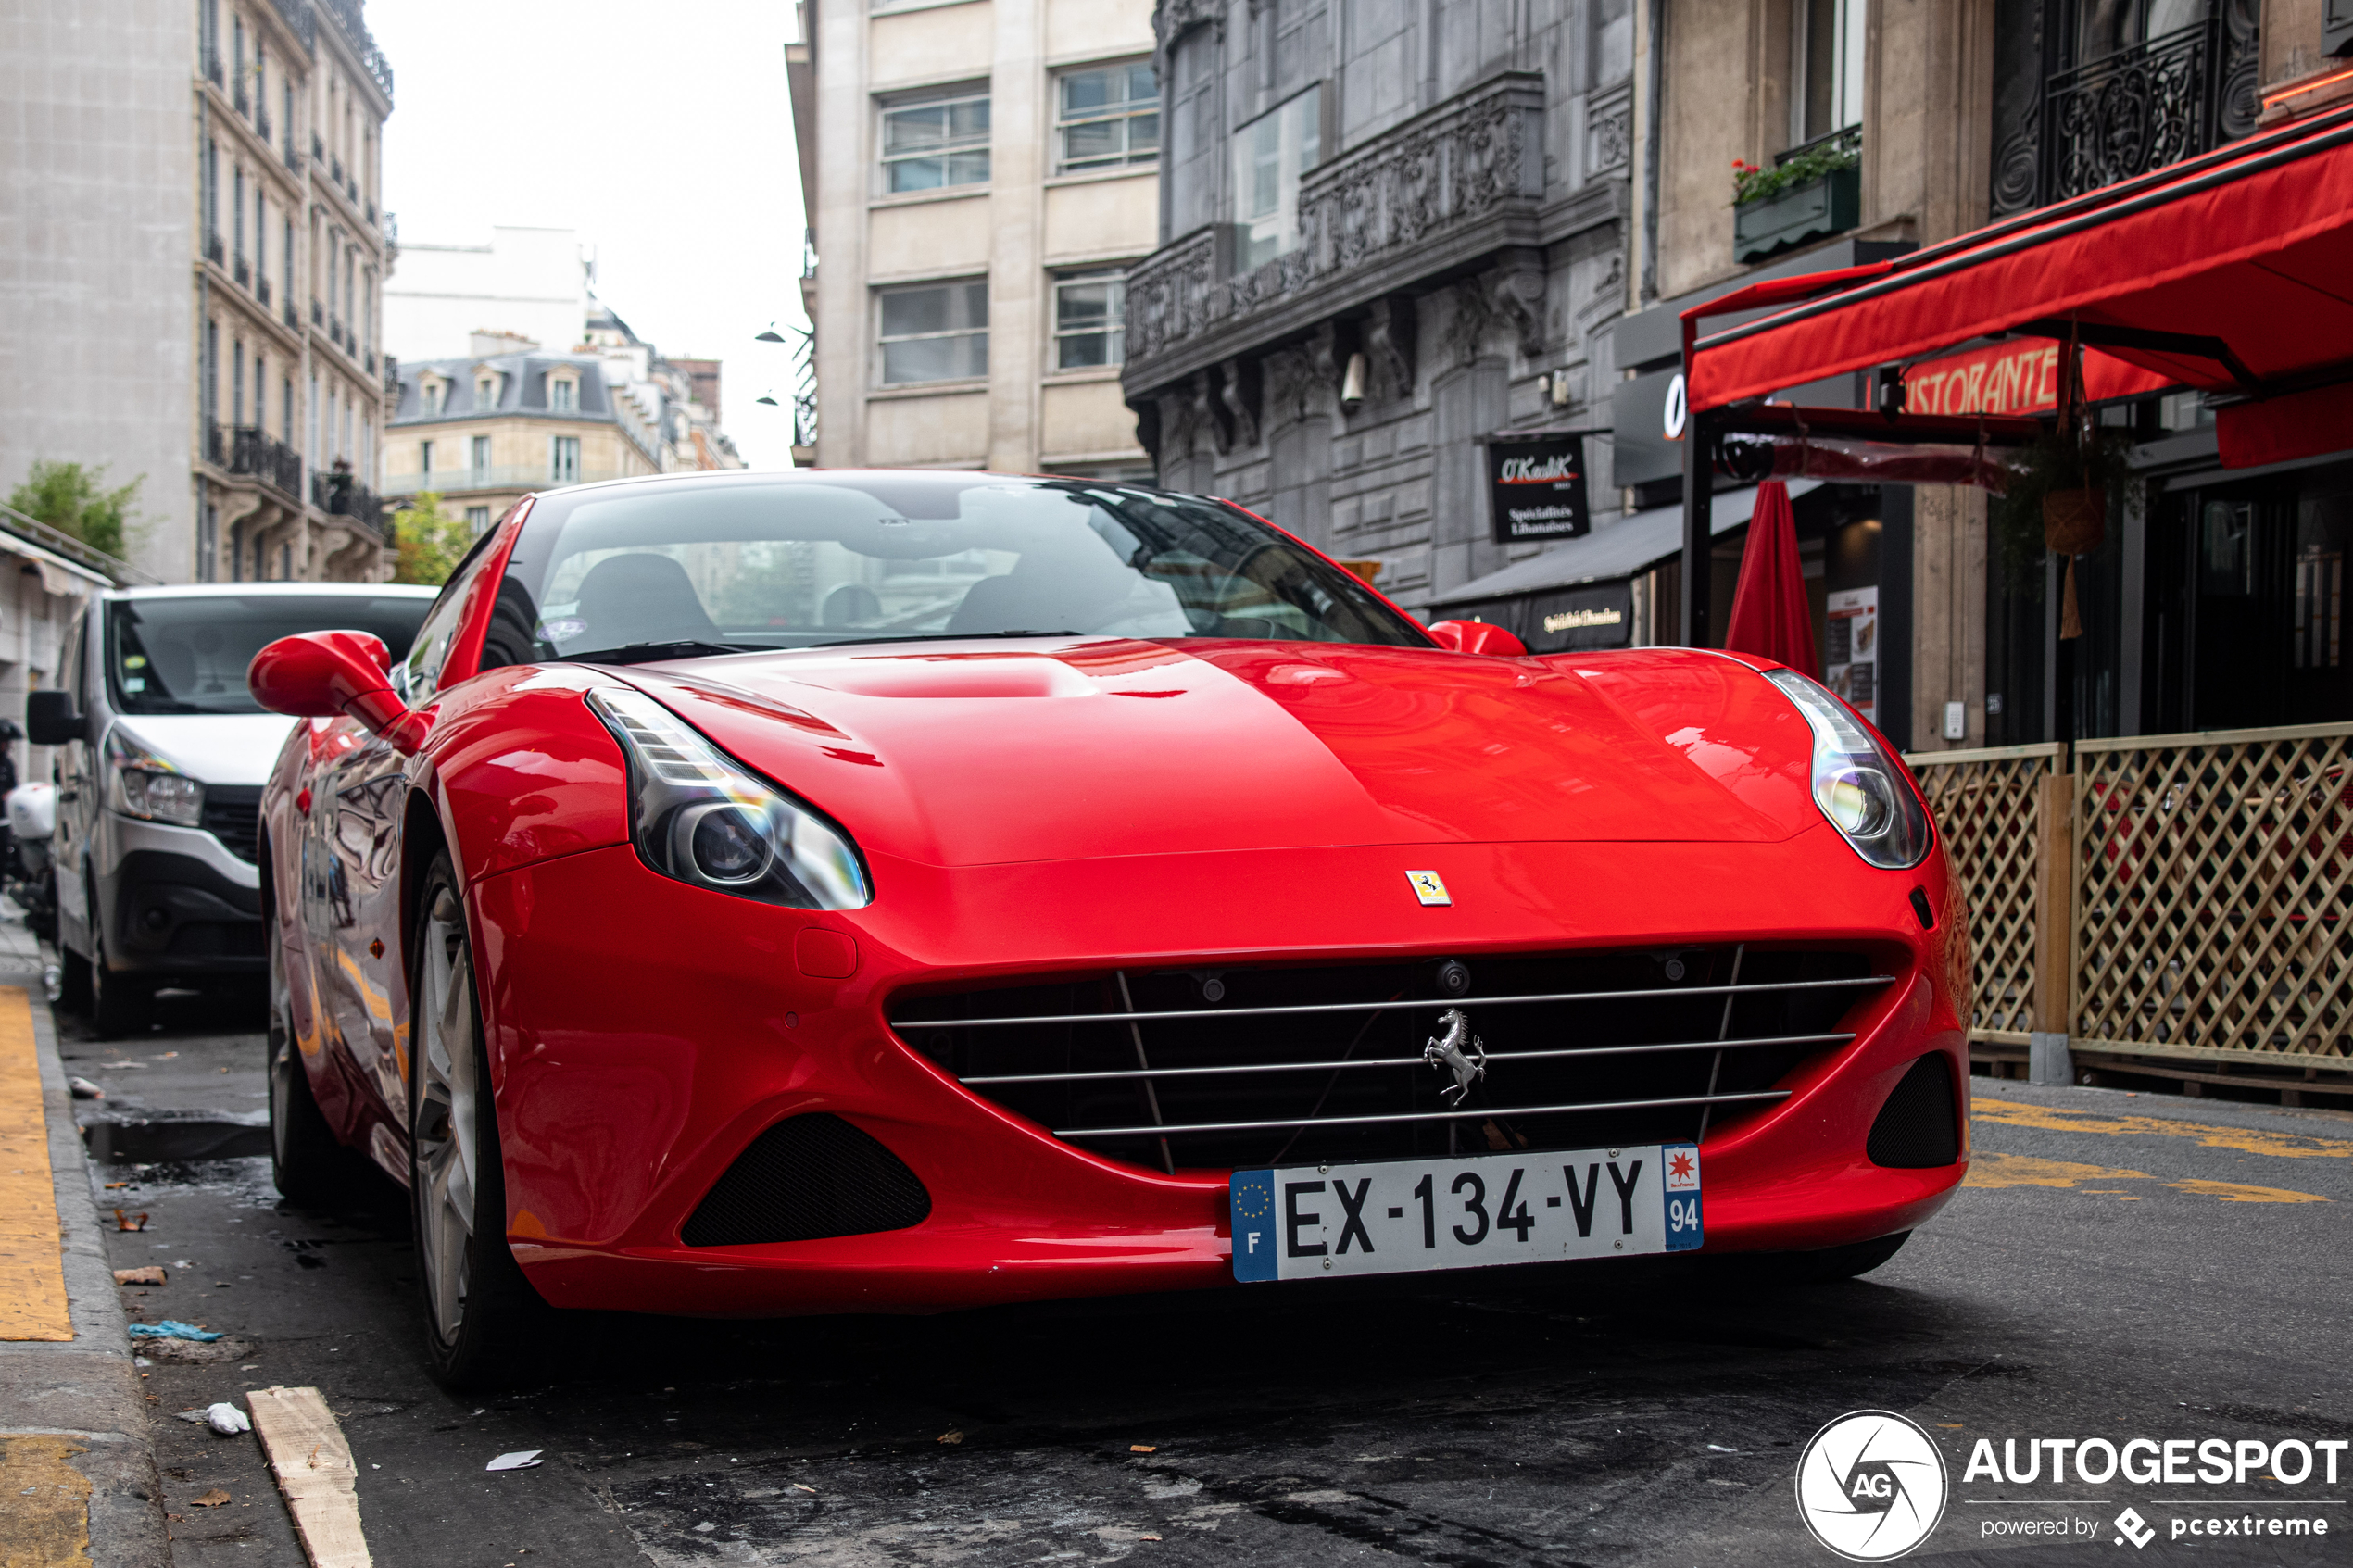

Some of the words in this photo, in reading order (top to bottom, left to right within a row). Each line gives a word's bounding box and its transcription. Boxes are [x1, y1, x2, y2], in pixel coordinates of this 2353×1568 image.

[1905, 346, 2058, 414] ISTORANTE
[1509, 505, 1573, 522] Spécialités
[1511, 520, 1573, 535] Libanaises
[1285, 1160, 1642, 1258] EX-134-VY
[1670, 1198, 1699, 1233] 94
[1248, 1232, 1261, 1254] F
